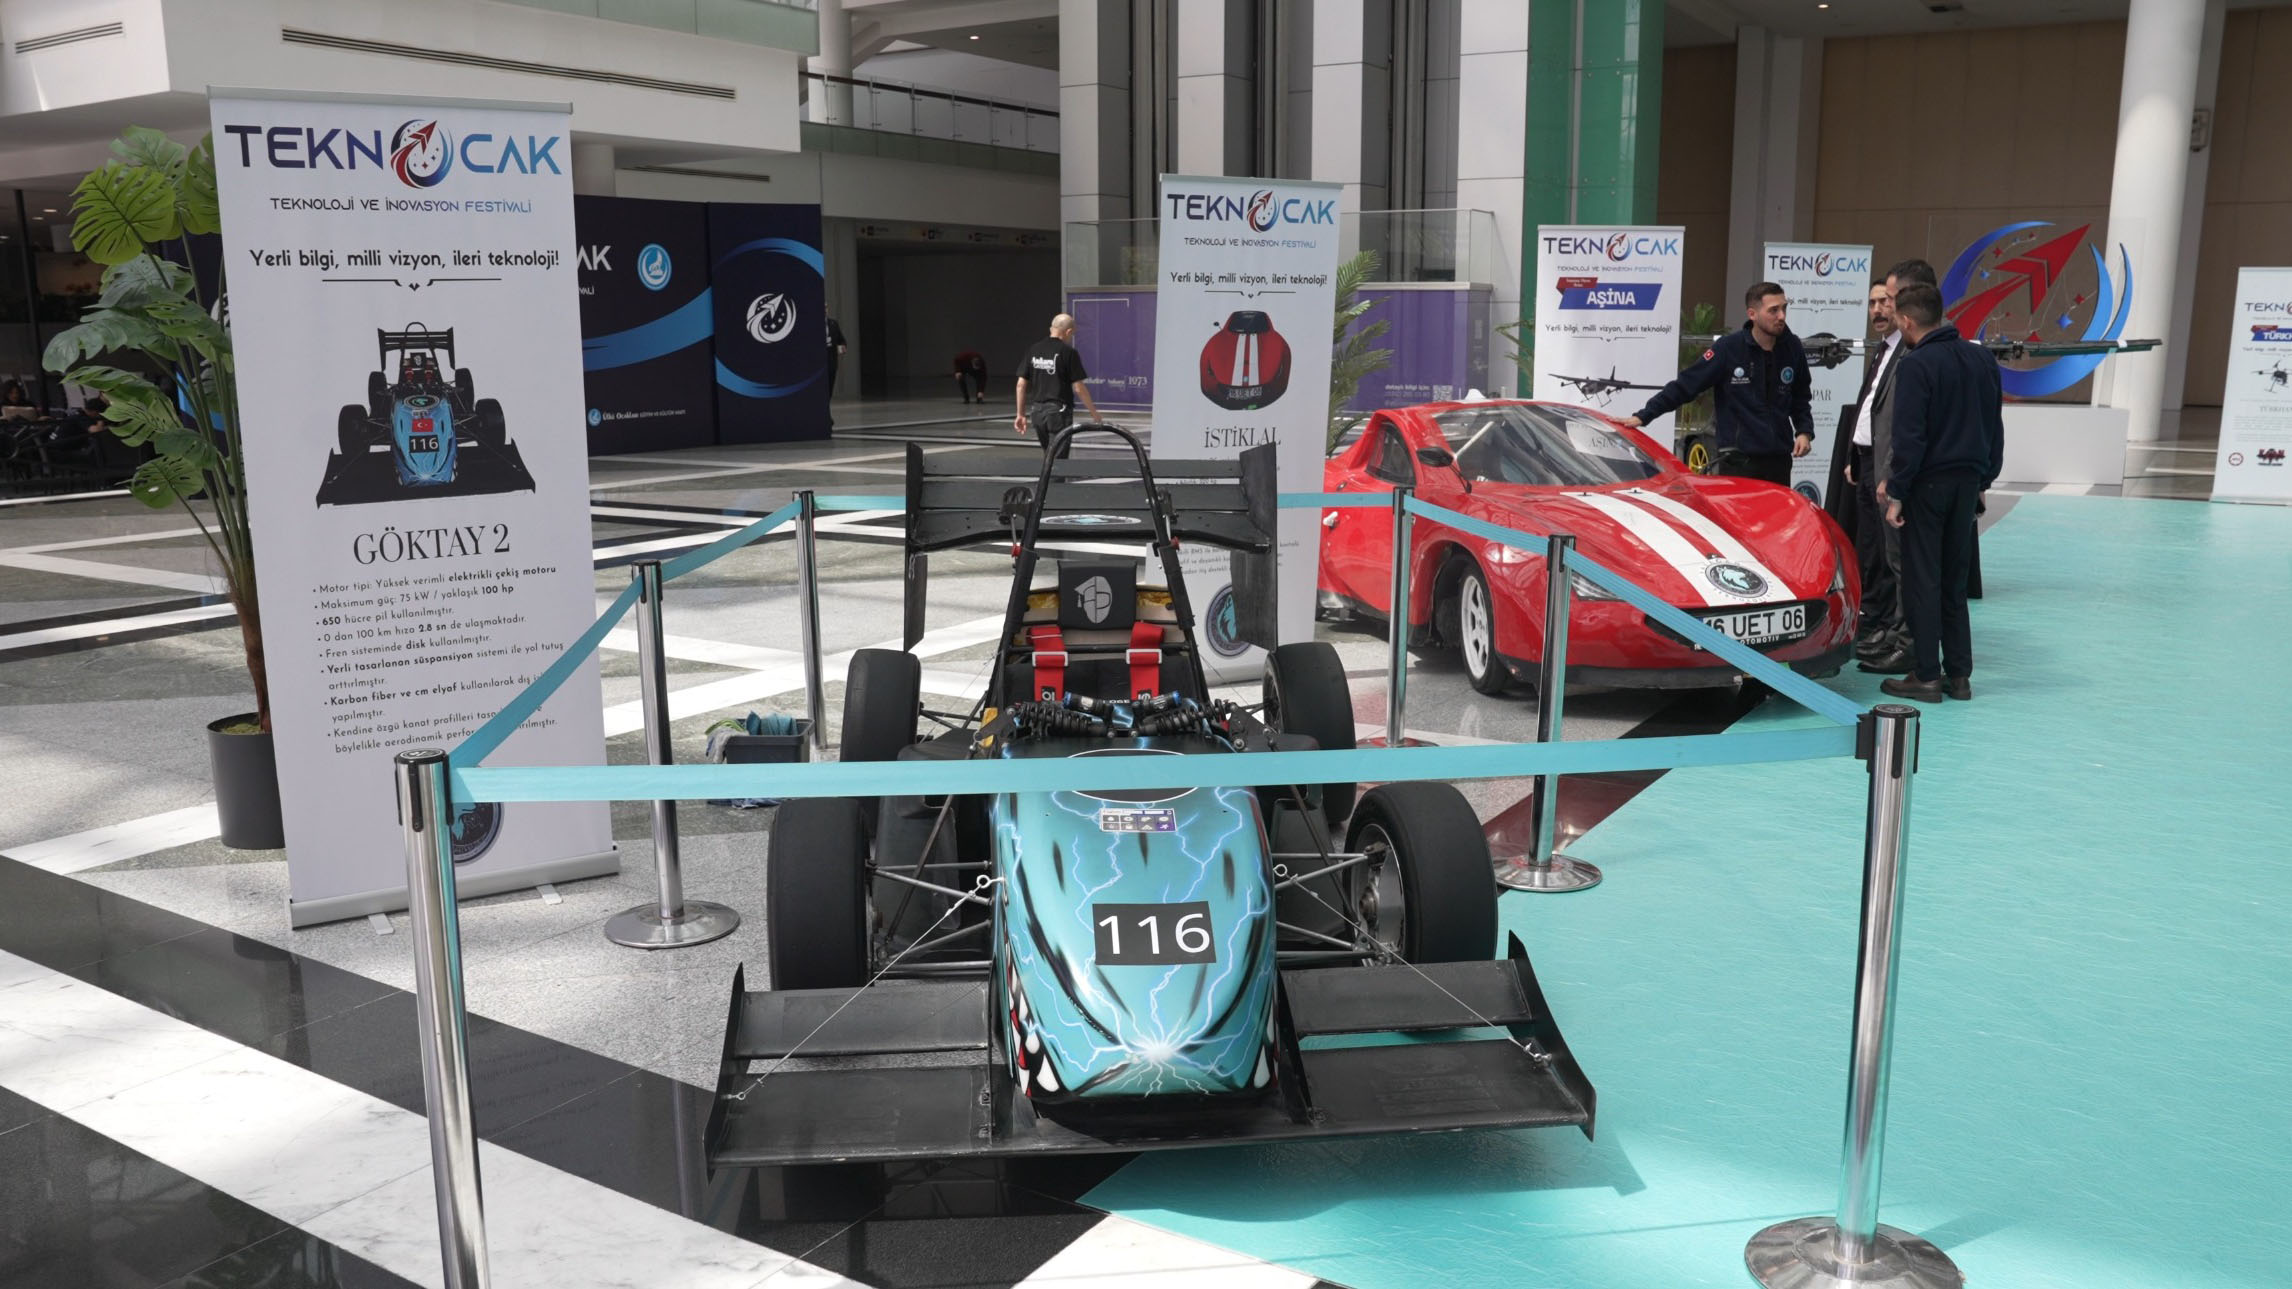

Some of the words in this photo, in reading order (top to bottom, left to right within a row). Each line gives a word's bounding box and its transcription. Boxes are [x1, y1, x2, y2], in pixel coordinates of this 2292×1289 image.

[270, 196, 354, 211] TEKNOLOJİ
[362, 199, 379, 211] VE
[386, 197, 459, 212] İNOVASYON
[465, 198, 532, 213] FESTİVALİ
[1184, 237, 1226, 247] TEKNOLOJİ
[1230, 238, 1239, 247] VE
[249, 249, 291, 267] Yerli
[300, 249, 339, 271] bilgi,
[347, 250, 381, 266] milli
[389, 251, 445, 270] vizyon,
[453, 250, 481, 266] ileri
[488, 249, 559, 270] teknoloji!
[1170, 272, 1191, 283] Yerli
[1194, 273, 1214, 286] bilgi,
[1218, 273, 1236, 284] milli
[1240, 274, 1268, 287] vizyon,
[1272, 273, 1287, 285] ileri
[1290, 274, 1327, 287] teknoloji!
[1586, 288, 1636, 308] AŞİNA
[1812, 389, 1832, 401] PAR
[410, 437, 439, 451] 116
[353, 525, 486, 565] GÖKTAY
[493, 523, 510, 553] 2
[319, 584, 349, 593] Motor
[353, 582, 372, 592] tipi:
[376, 576, 410, 589] Yüksek
[413, 573, 445, 585] verimli
[449, 569, 492, 582] elektrikli
[496, 568, 519, 579] çekiş
[523, 566, 556, 576] motoru
[321, 599, 374, 610] Maksimum
[400, 594, 411, 602] 75
[414, 591, 429, 601] kW
[434, 590, 438, 600] /
[441, 587, 478, 600] yaklaşık
[482, 585, 498, 594] 100
[502, 584, 514, 594] hp
[322, 616, 341, 626] 650
[344, 614, 372, 624] hücre
[375, 611, 387, 623] pil
[1733, 611, 1775, 638] UET
[1782, 608, 1803, 631] 06
[334, 632, 353, 641] dan
[357, 629, 374, 639] 100
[377, 627, 391, 637] km
[395, 626, 415, 635] hıza
[418, 623, 432, 633] 2.8
[436, 623, 447, 631] sn
[450, 620, 462, 629] de
[326, 648, 347, 658] Fren
[351, 642, 402, 656] sisteminde
[406, 639, 426, 650] disk
[327, 662, 351, 674] Yerli
[355, 659, 410, 671] tasarlanan
[414, 651, 473, 665] süspansiyon
[476, 648, 508, 658] sistemi
[511, 644, 522, 654] ile
[525, 642, 538, 654] yol
[541, 642, 564, 651] tutuş
[330, 695, 368, 706] Karbon
[372, 691, 397, 701] fiber
[432, 682, 456, 695] elyaf
[461, 675, 514, 691] kullanılarak
[518, 674, 531, 685] dış
[334, 726, 373, 738] Kendine
[377, 723, 400, 733] özgü
[403, 719, 429, 729] kanat
[434, 712, 473, 727] profilleri
[335, 740, 381, 753] böylelikle
[385, 731, 443, 747] aerodinamik
[1099, 913, 1210, 955] 116
